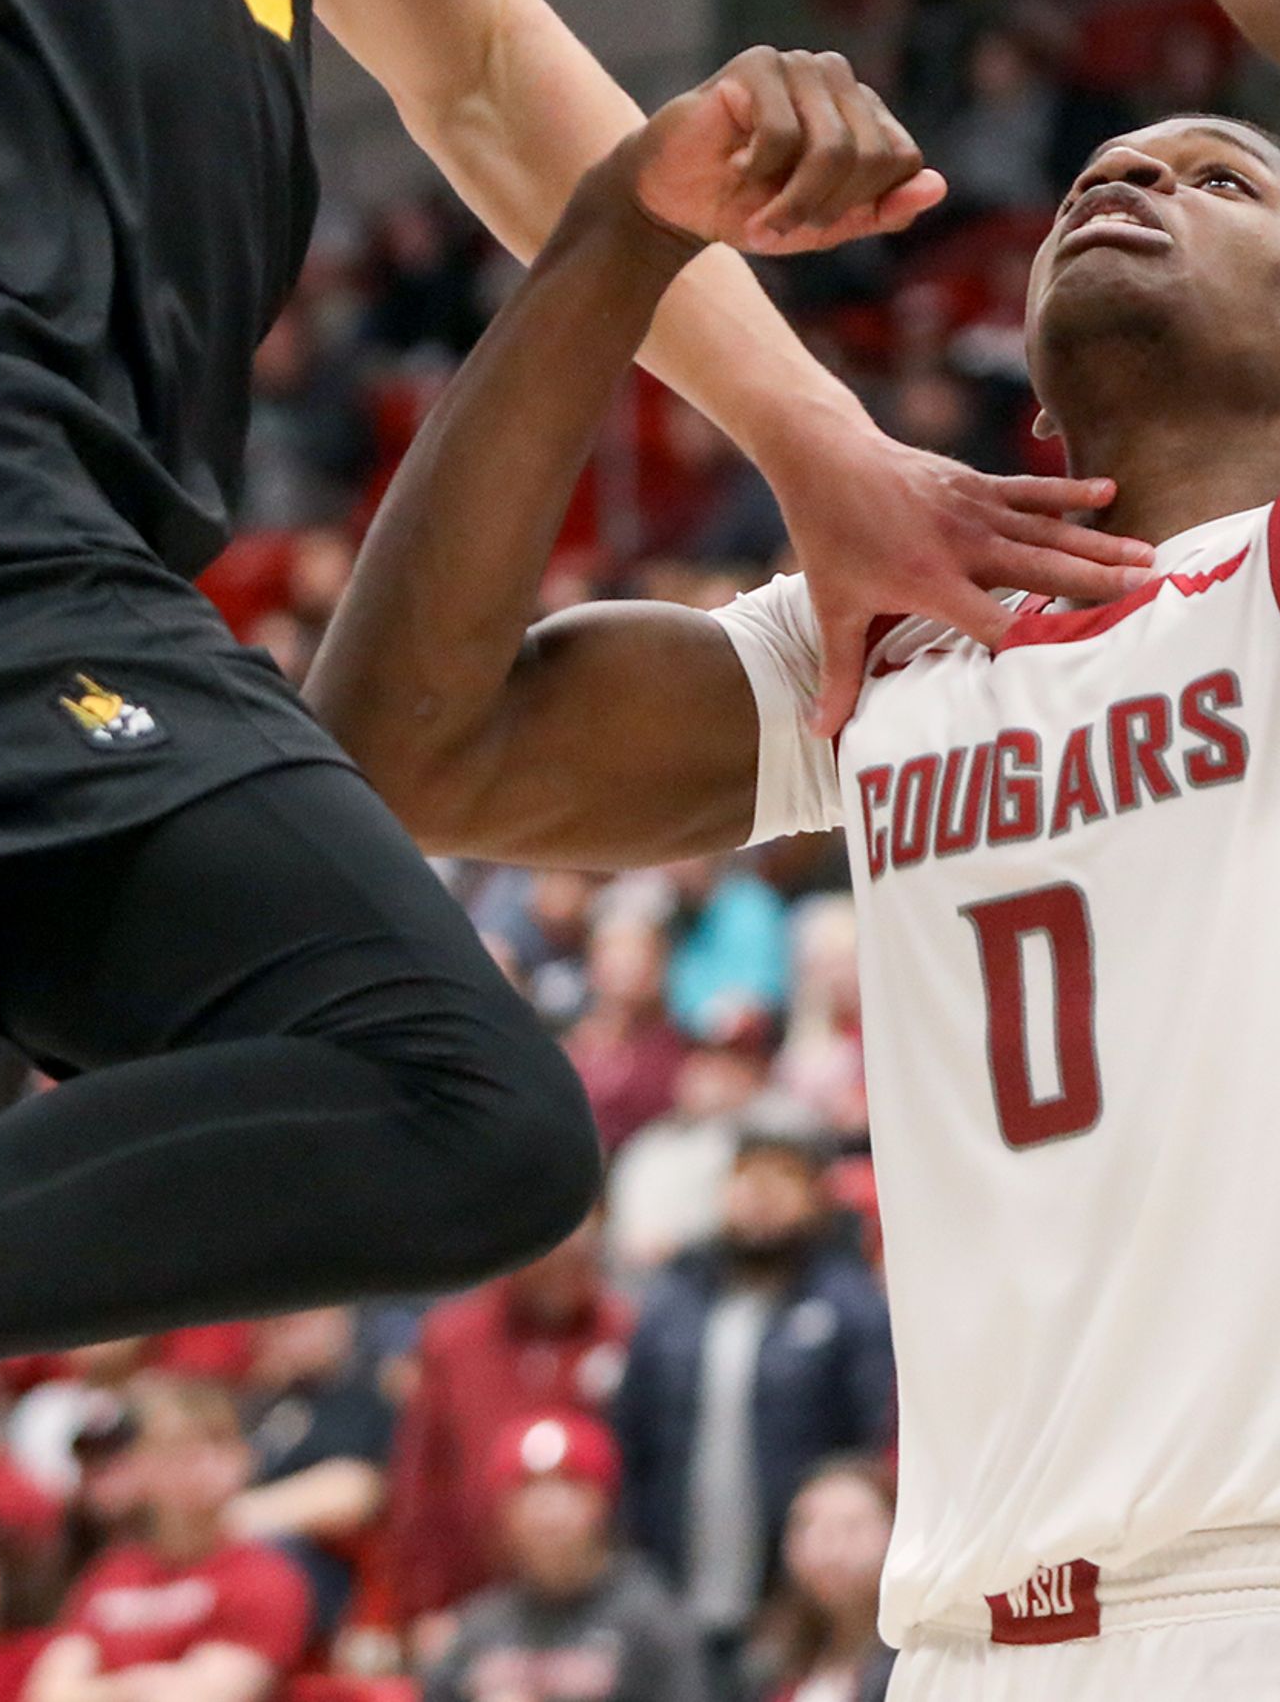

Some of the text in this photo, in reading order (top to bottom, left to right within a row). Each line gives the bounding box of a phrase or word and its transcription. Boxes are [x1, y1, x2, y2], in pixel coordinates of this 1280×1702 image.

[856, 668, 1251, 882] COUGARS
[956, 880, 1103, 1151] 0
[1006, 1563, 1075, 1619] WSU
